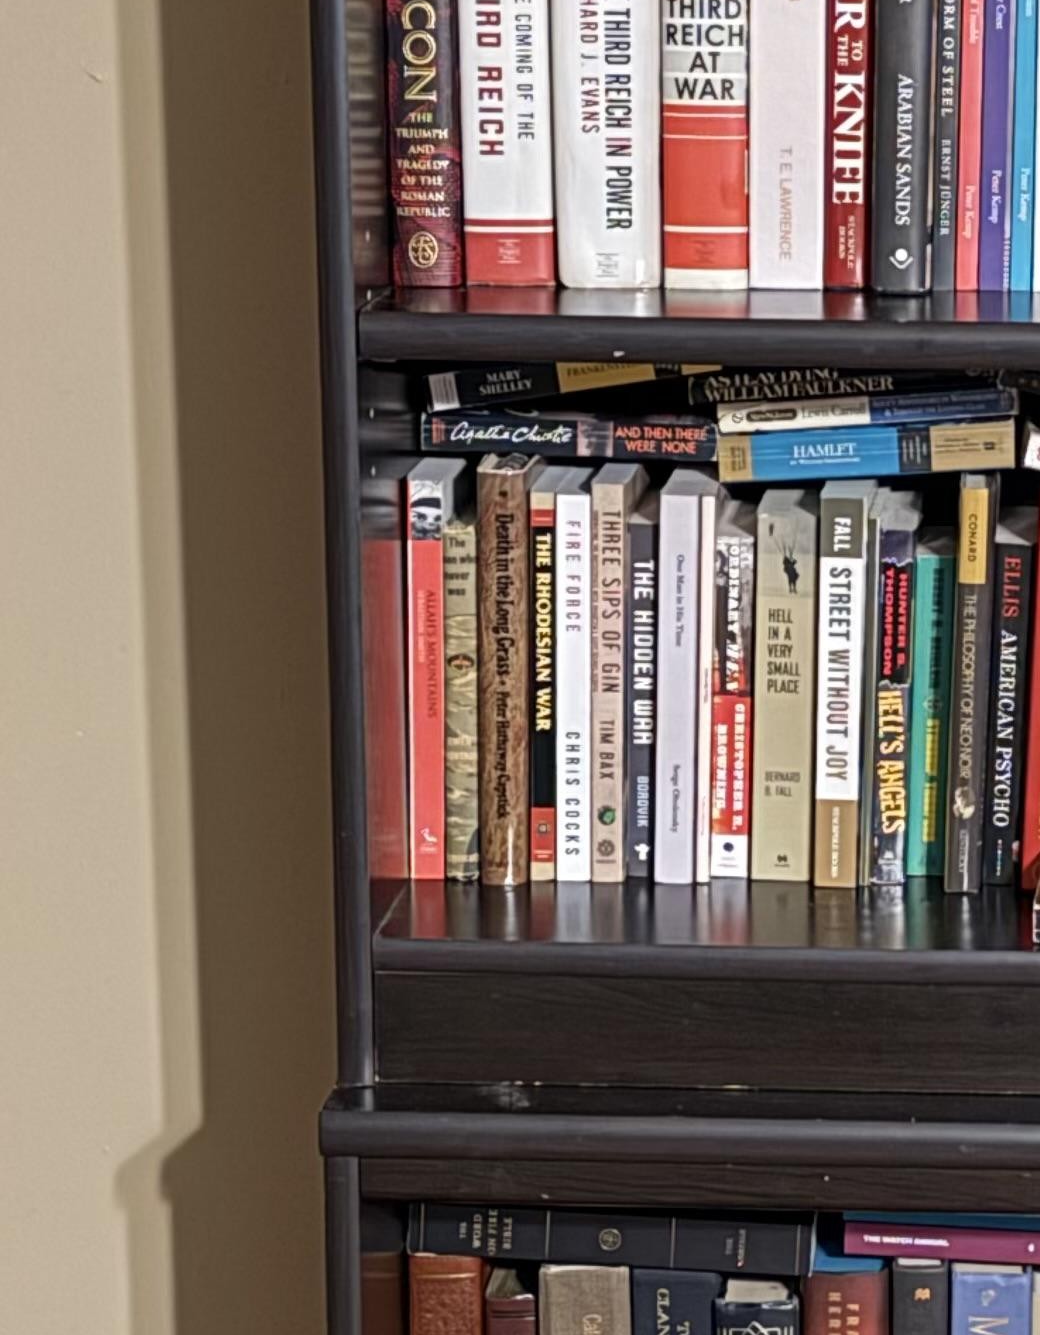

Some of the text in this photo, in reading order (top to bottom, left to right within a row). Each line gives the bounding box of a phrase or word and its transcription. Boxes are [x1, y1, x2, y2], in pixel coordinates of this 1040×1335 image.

[604, 8, 631, 65] THIRD
[666, 23, 743, 46] REICH
[674, 77, 734, 100] WAR
[690, 53, 721, 73] AT
[410, 113, 433, 123] THE
[477, 66, 505, 157] REICH
[581, 77, 599, 134] EVANS
[605, 72, 631, 131] REICH
[941, 69, 954, 117] STEEL
[395, 128, 448, 139] TRIUMPH
[605, 137, 631, 157] IN
[833, 70, 865, 206] KNIFE
[895, 74, 914, 226] ARABIAN SANDS
[397, 206, 450, 217] REPUBLIC
[606, 166, 632, 230] POWER
[615, 427, 672, 440] AND THEN
[625, 441, 697, 454] WERE NONE
[792, 443, 856, 459] HAMLET
[565, 521, 581, 632] FIRE FORCE
[1003, 557, 1021, 617] ELLIS
[535, 532, 552, 732] THE RHODESIAN WAR
[768, 608, 793, 624] HELL
[633, 607, 654, 745] HIDDEN WAR
[767, 662, 800, 677] SMALL
[767, 679, 800, 695] PLACE
[825, 566, 852, 783] STREET WITHOUT JOY
[993, 630, 1017, 827] AMERICAN PSYCHO
[565, 730, 581, 856] CHRIS COCKS
